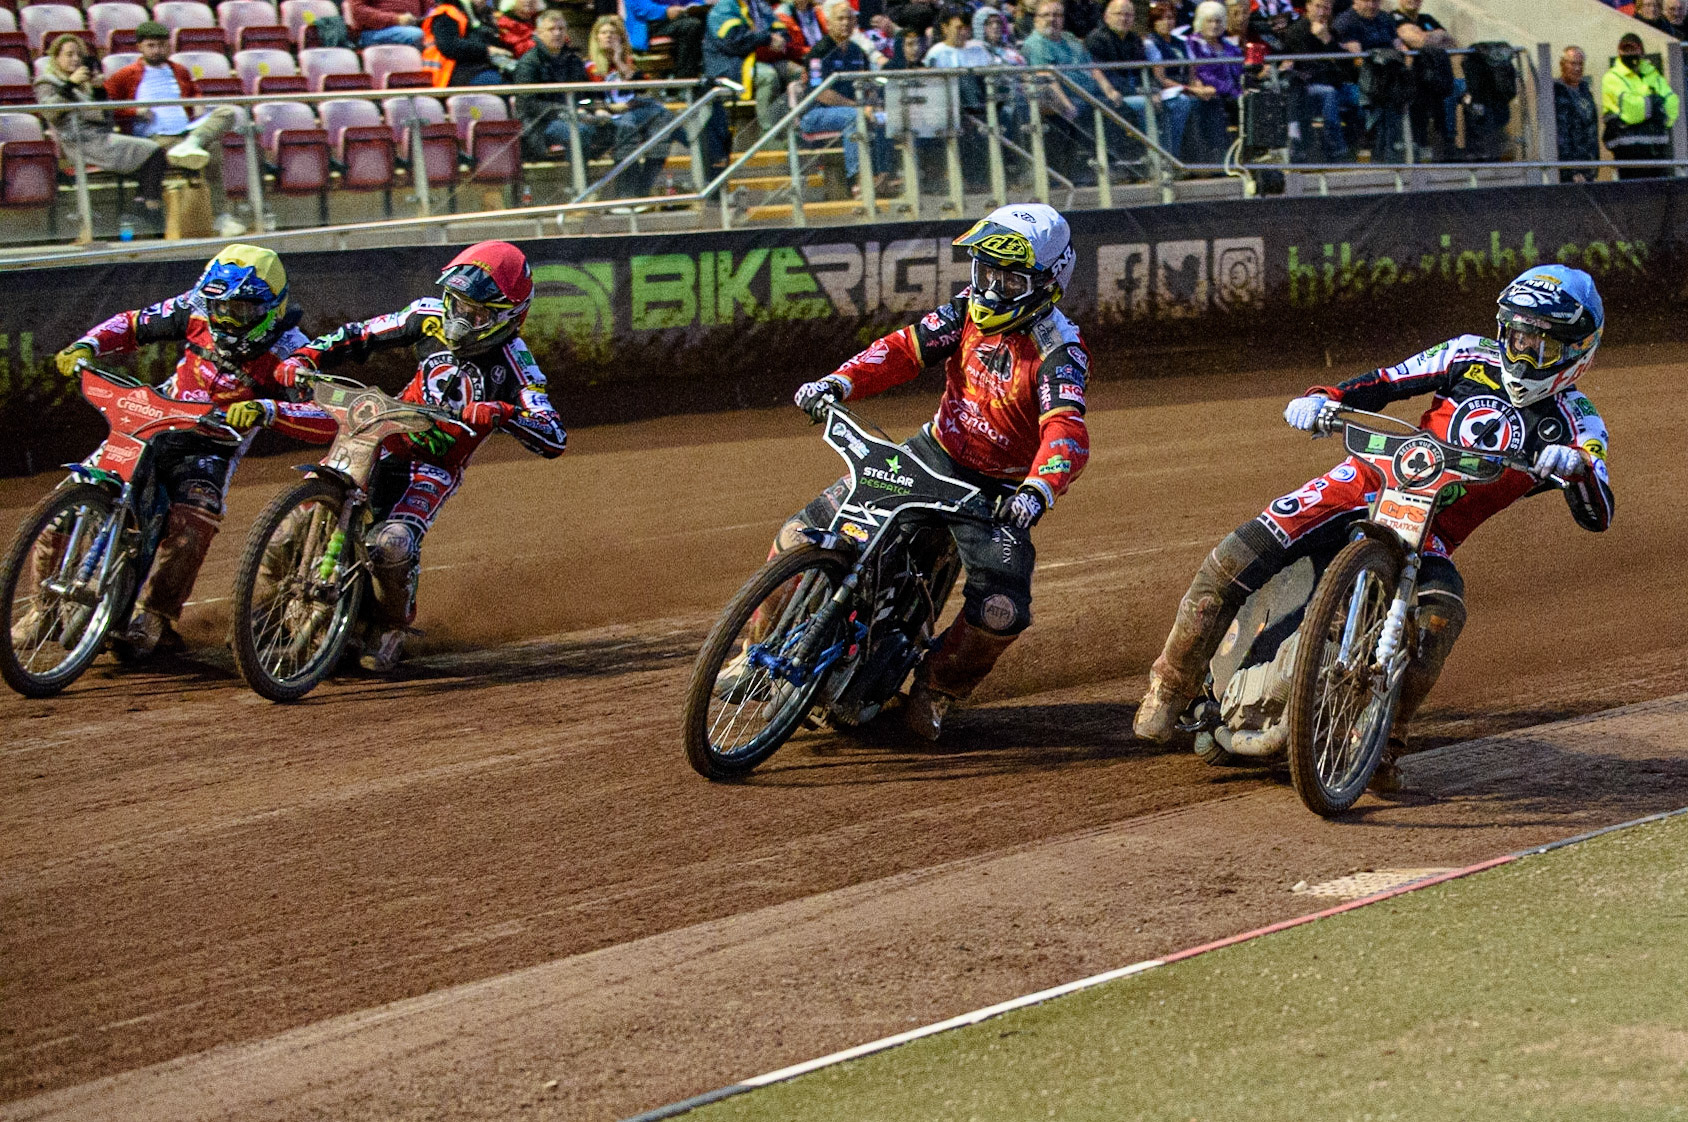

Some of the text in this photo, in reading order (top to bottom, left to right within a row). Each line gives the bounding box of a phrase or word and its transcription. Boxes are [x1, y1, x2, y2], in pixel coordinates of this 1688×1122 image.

[429, 355, 454, 369] BELLE
[117, 397, 164, 419] Crendon
[1467, 399, 1521, 451] BELLE VUE ACES
[1399, 440, 1416, 456] BELLE
[1418, 440, 1432, 448] VUE
[859, 477, 911, 496] DESPATCH
[863, 466, 915, 488] STELLAR
